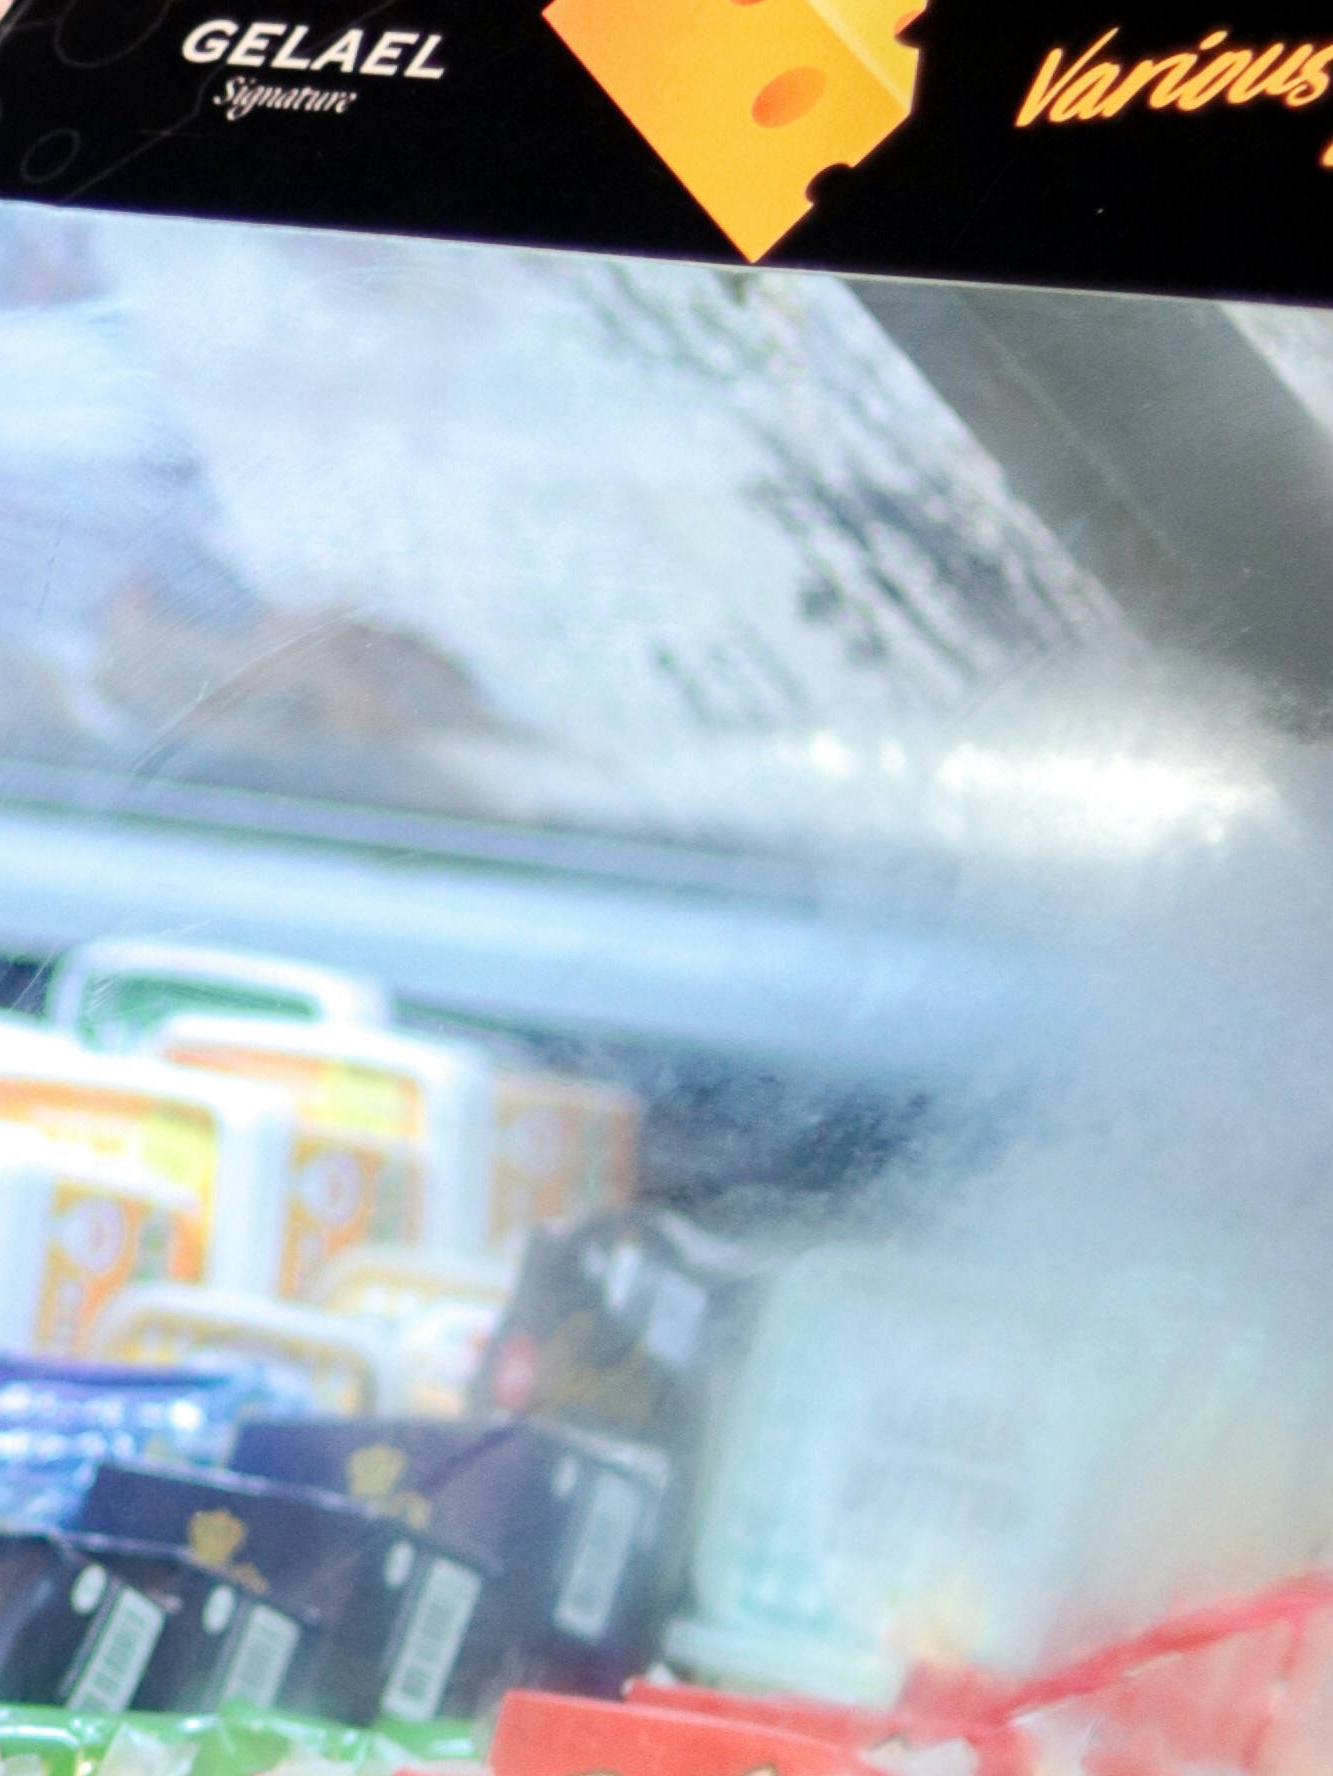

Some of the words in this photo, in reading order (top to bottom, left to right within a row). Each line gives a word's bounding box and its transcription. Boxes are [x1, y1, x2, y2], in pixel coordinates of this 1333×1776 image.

[180, 19, 447, 81] GELAEL
[1015, 26, 1333, 128] Various
[213, 76, 357, 121] Signature
